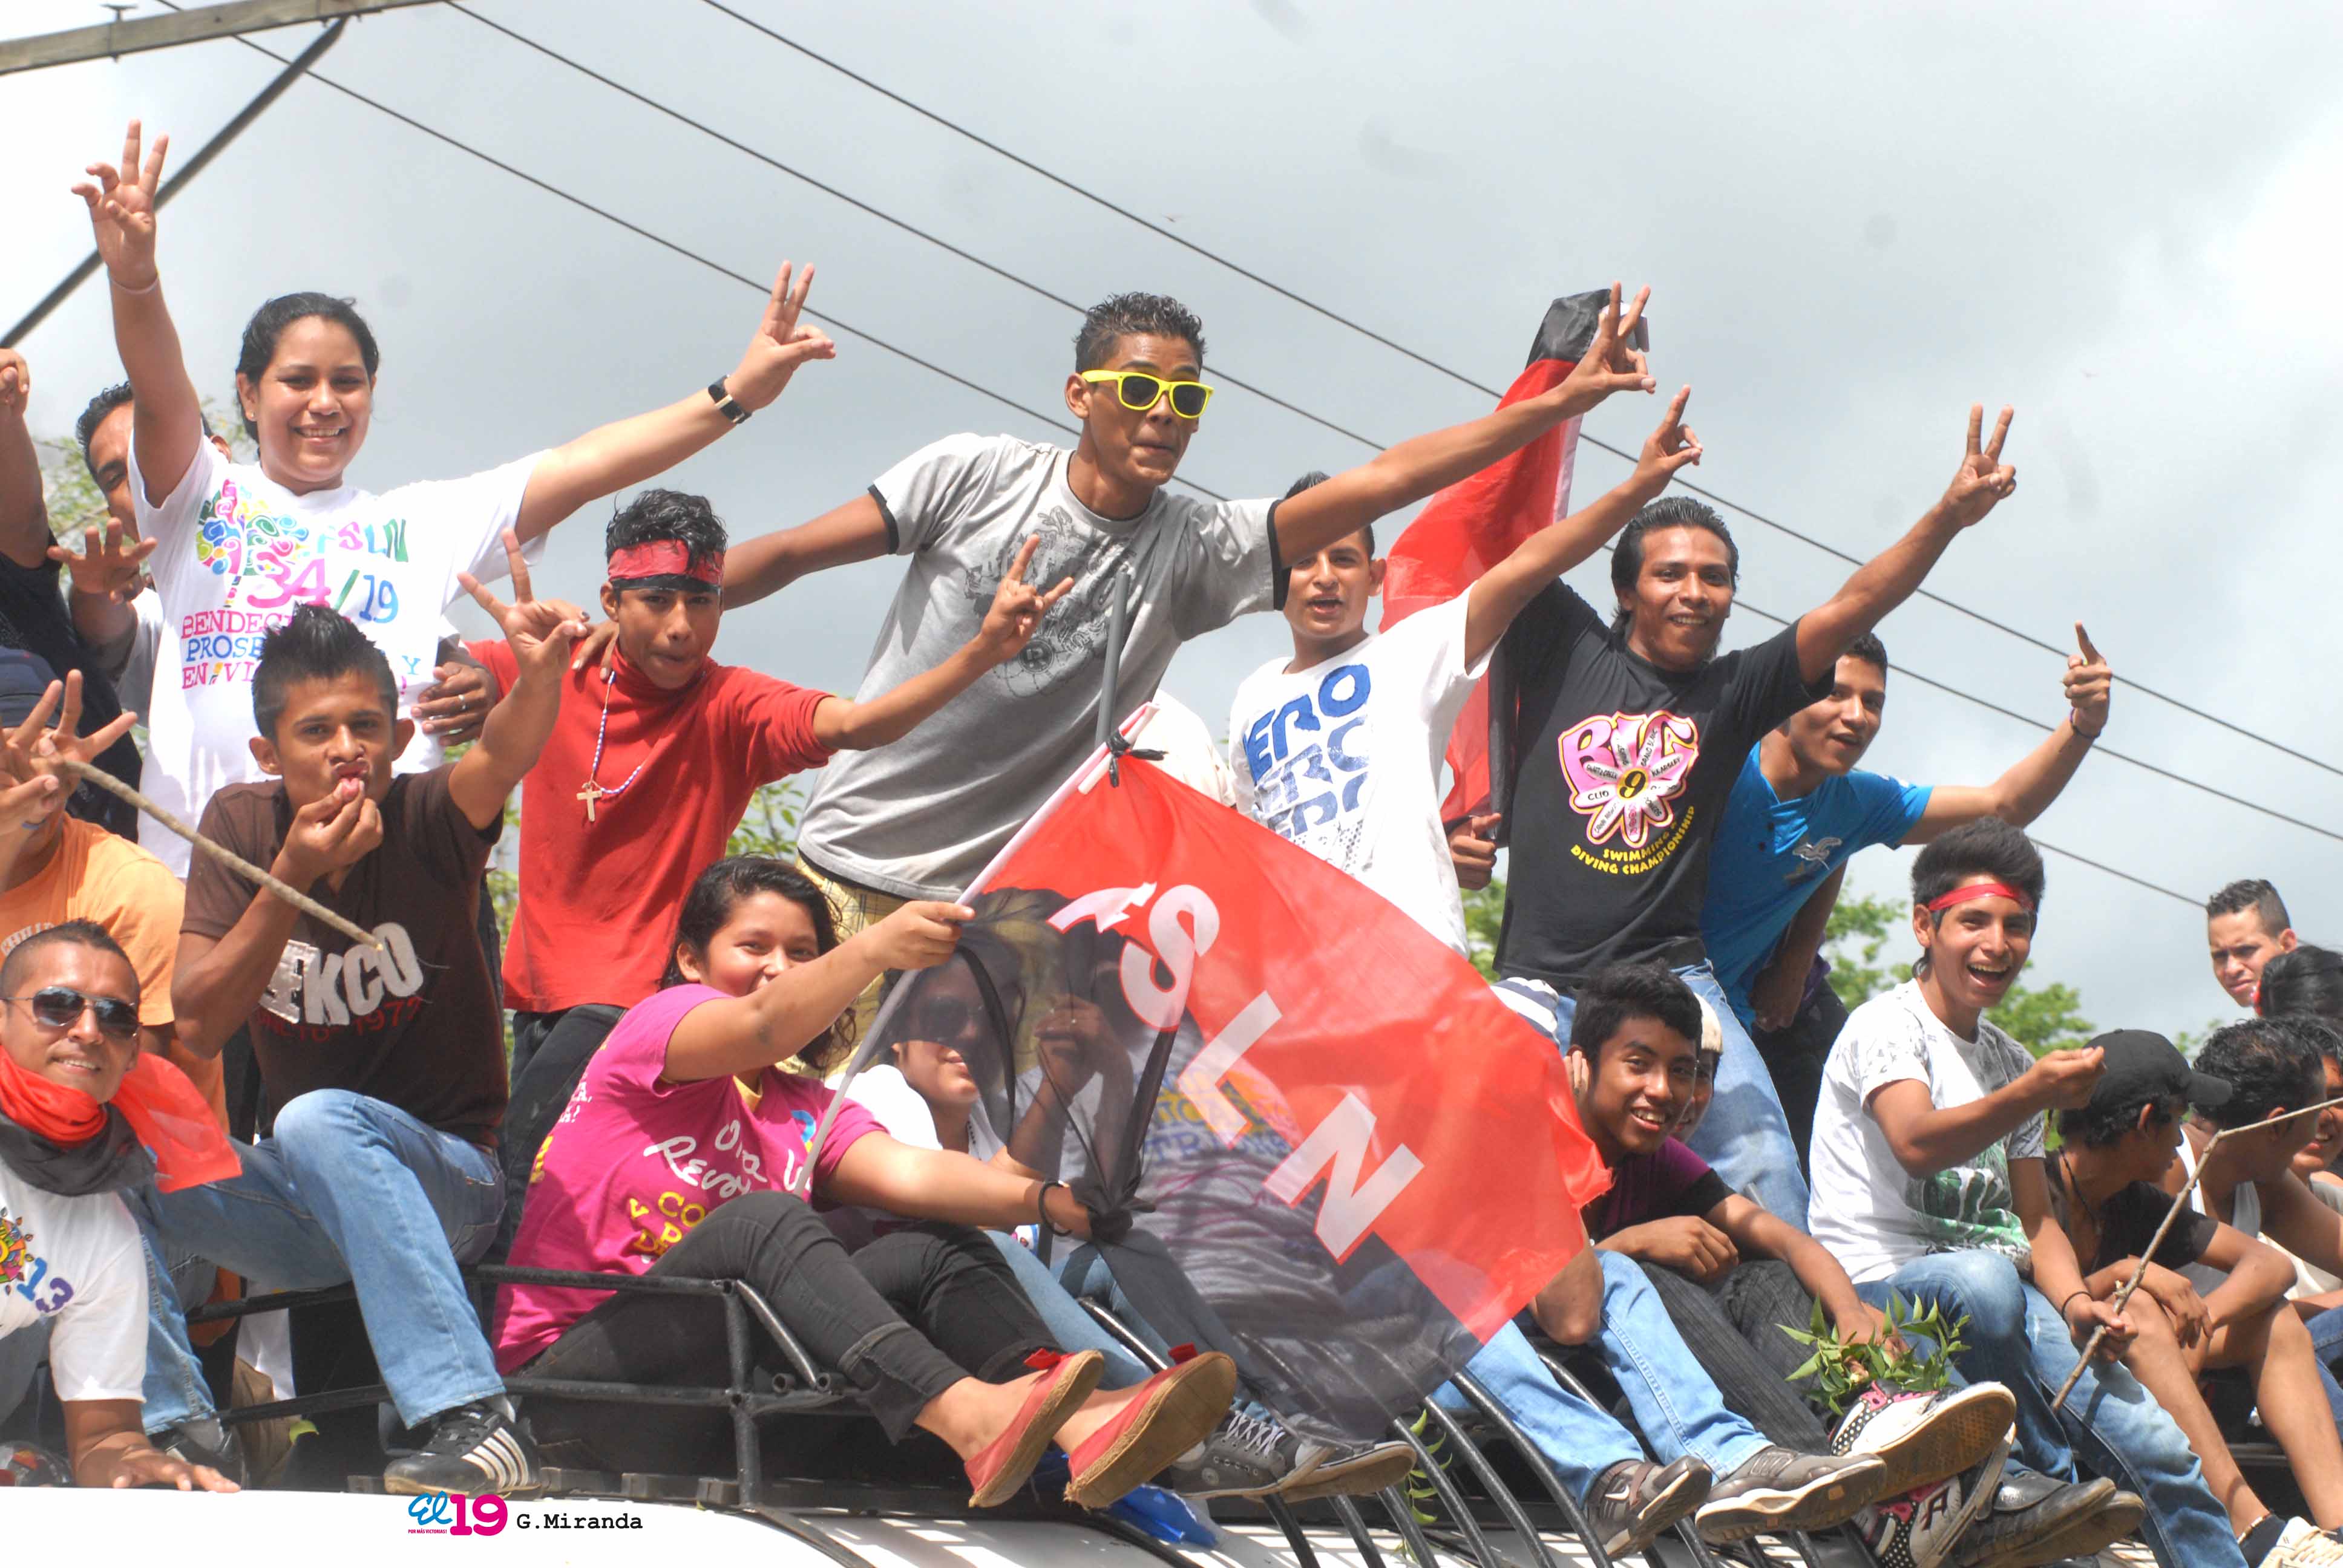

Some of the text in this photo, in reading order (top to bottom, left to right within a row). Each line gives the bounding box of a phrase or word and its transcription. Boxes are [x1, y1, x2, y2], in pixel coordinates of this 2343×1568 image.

[1587, 790, 1610, 800] CLIO
[1570, 844, 1618, 874] DIVING
[1622, 805, 1695, 875] CHAMPIONSHIP
[1602, 831, 1670, 862] SWIMMING
